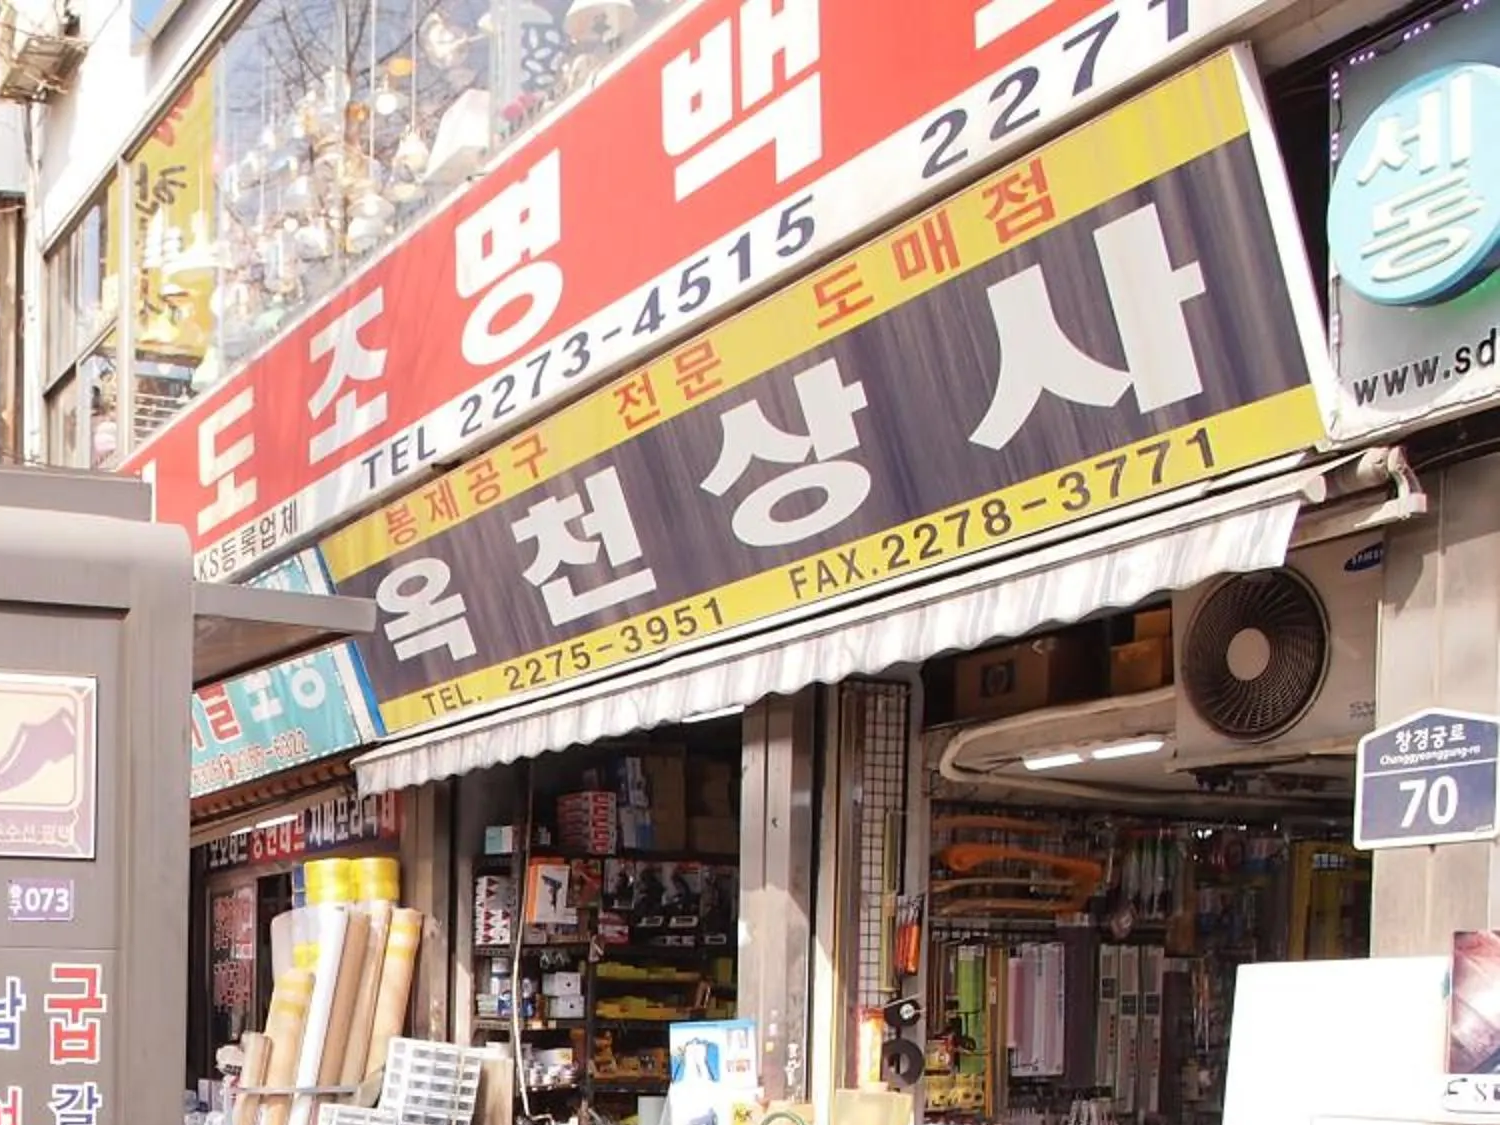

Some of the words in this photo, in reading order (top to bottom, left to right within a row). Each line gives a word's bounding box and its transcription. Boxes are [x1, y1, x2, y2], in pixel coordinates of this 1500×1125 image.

[362, 424, 438, 492] TEL
[459, 194, 817, 439] 2273-4515
[385, 436, 551, 546] 봉제공구
[614, 345, 725, 432] 전문
[814, 156, 1057, 330] 도매점
[503, 596, 726, 692] 2275-3951
[1395, 723, 1466, 753] 창경궁로
[1399, 775, 1459, 829] 70
[24, 886, 69, 913] 073
